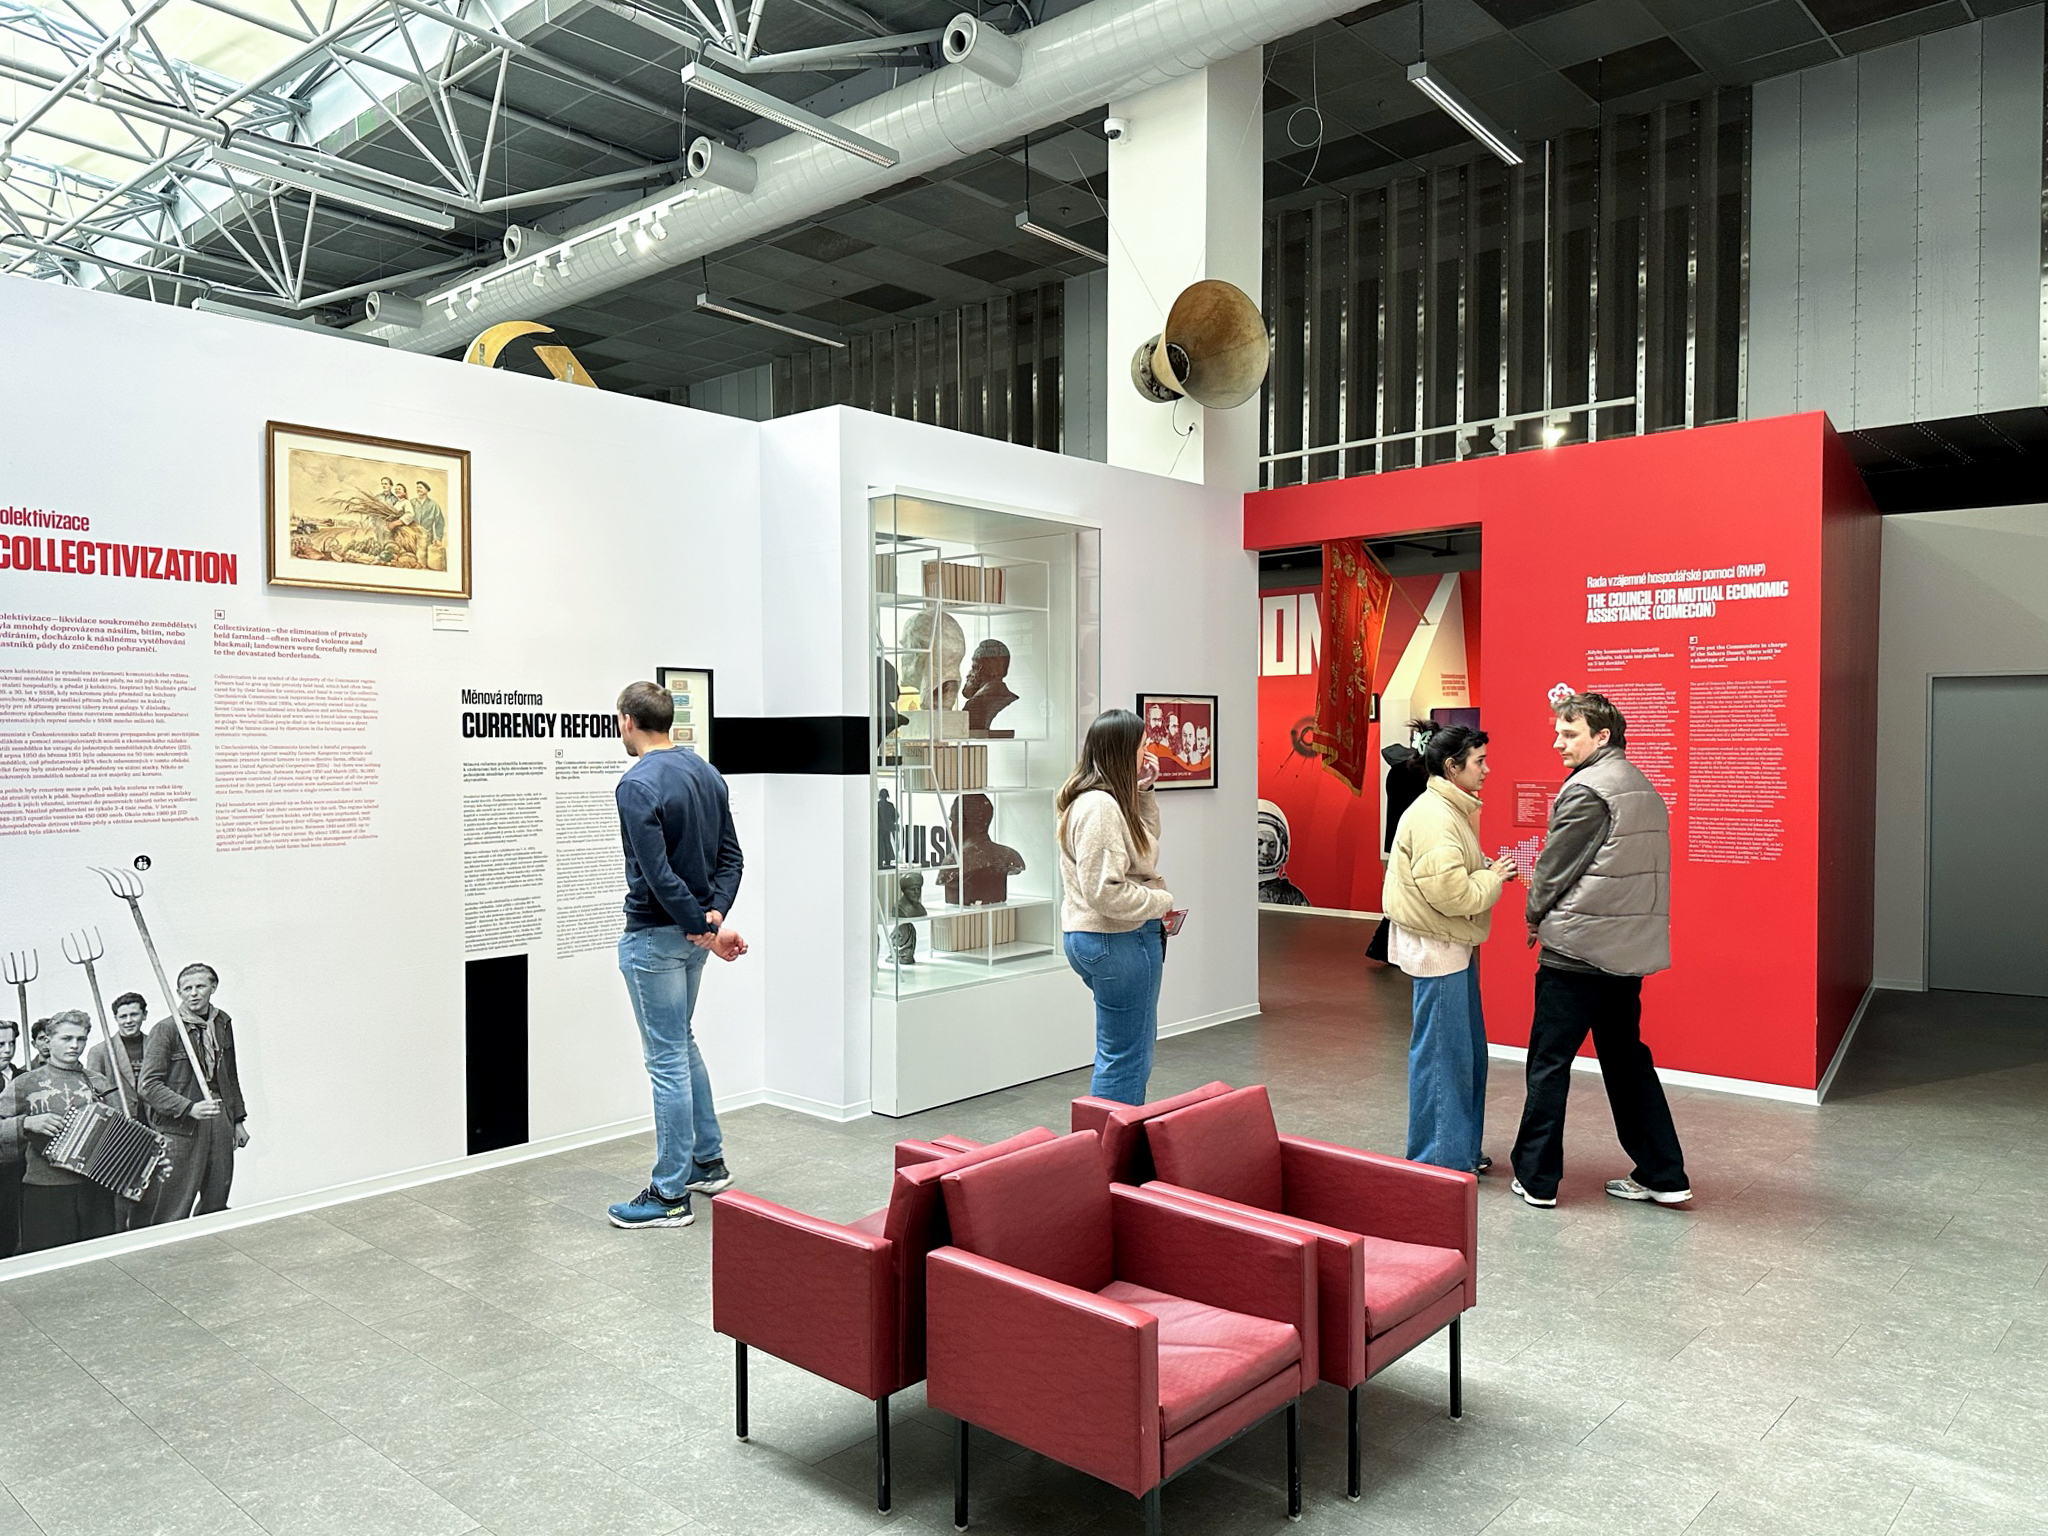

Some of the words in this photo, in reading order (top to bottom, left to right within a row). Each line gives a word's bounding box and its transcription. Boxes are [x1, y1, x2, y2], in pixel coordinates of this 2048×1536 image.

[0, 506, 90, 531] olektivizace
[1587, 576, 1607, 589] Rada
[1608, 573, 1646, 590] vzájemné
[1647, 569, 1702, 587] hospodářské
[1702, 566, 1735, 583] pomoci
[1736, 564, 1766, 580] (RVHP)
[1588, 593, 1606, 608] THE
[1608, 591, 1653, 607] COUNCIL
[1655, 589, 1676, 604] FOR
[1678, 587, 1724, 603] MUTUAL
[1726, 583, 1789, 600] ECONOMIC
[1587, 606, 1650, 624] ASSISTANCE
[1653, 603, 1716, 620] (COMECON)
[289, 628, 329, 637] elimination
[338, 630, 368, 641] privately
[290, 636, 320, 644] involved
[321, 637, 349, 646] violence
[214, 640, 253, 651] blackmail;
[254, 642, 296, 651] landowners
[315, 645, 347, 656] forcefully
[349, 646, 378, 655] removed
[237, 649, 276, 658] devastated
[277, 651, 322, 660] borderlands.
[462, 689, 501, 705] Měnová
[504, 690, 543, 706] reforma
[462, 712, 557, 738] CURRENCY
